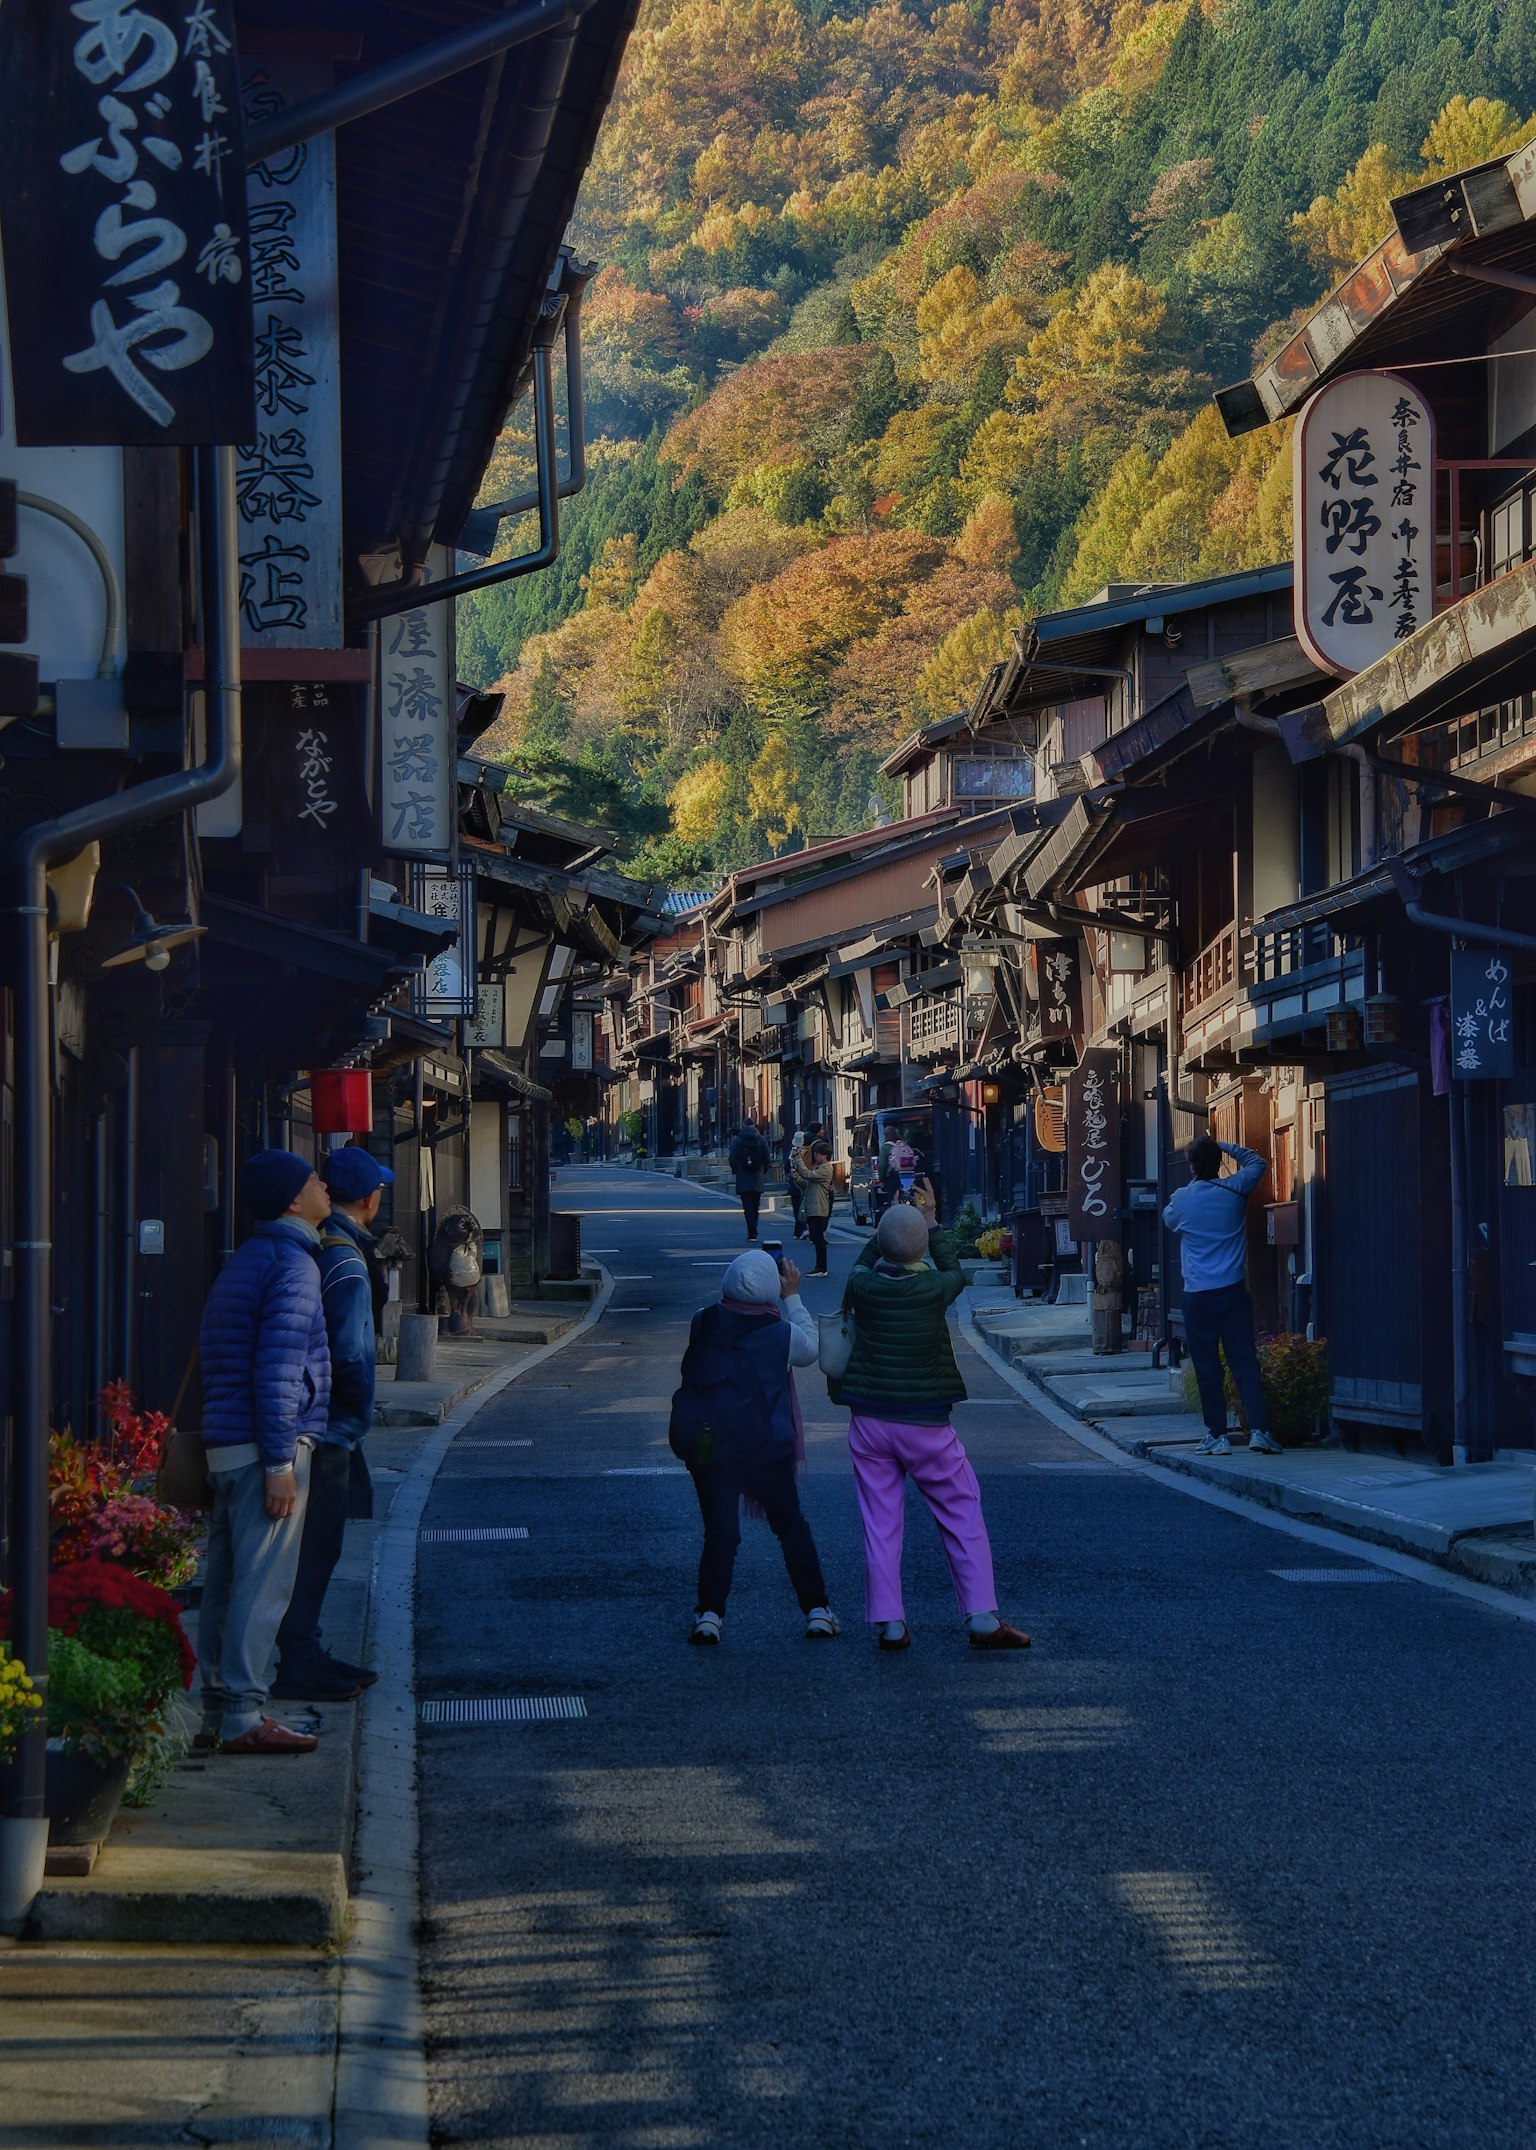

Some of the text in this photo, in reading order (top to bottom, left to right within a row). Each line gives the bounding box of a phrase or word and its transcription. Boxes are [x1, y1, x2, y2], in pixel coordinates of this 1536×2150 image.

[183, 0, 243, 285] 奈良井宿
[60, 0, 214, 428] あぶらや
[1389, 397, 1421, 507] 奈良井宿
[1319, 427, 1384, 628] 花野屋
[295, 728, 338, 829] ながとや
[1456, 1011, 1482, 1069] 漆の器
[1475, 999, 1488, 1017] &
[1485, 957, 1510, 1043] めんぱ
